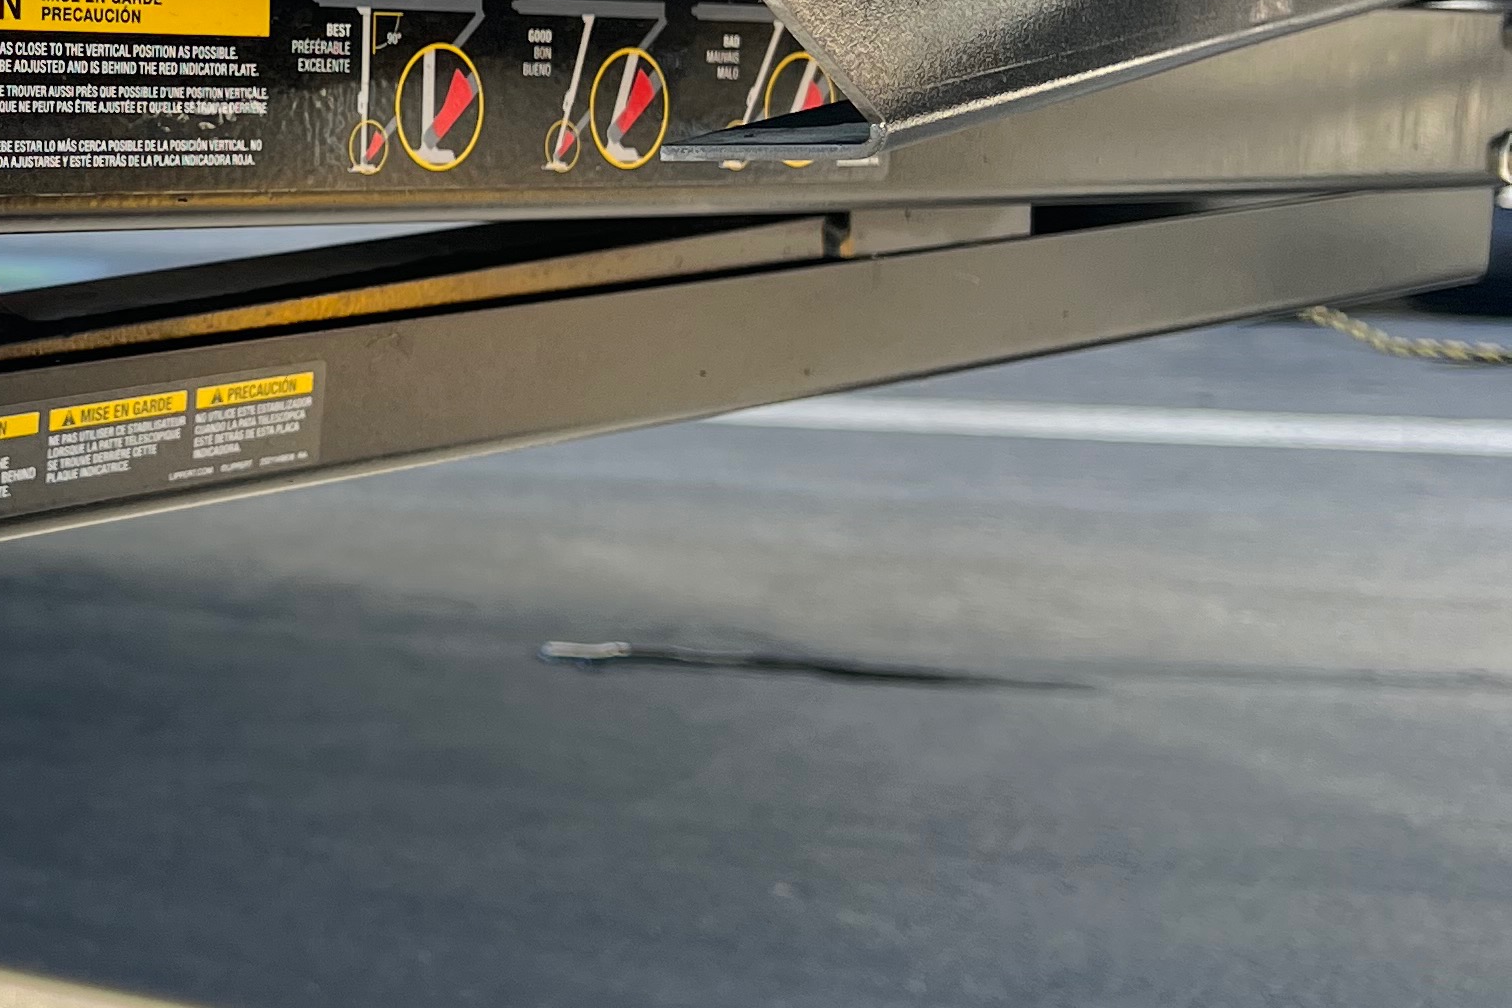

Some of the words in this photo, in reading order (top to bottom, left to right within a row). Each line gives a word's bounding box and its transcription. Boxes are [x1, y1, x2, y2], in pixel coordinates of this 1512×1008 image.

[41, 4, 143, 24] PRECAUCIÓN
[326, 22, 352, 38] BEST
[527, 28, 553, 44] GOOD
[15, 41, 48, 56] CLOSE
[49, 42, 63, 56] TO
[64, 42, 84, 57] THE
[85, 43, 131, 58] VERTICAL
[132, 44, 176, 58] POSITION
[177, 45, 191, 59] AS
[192, 45, 239, 60] POSSIBLE.
[291, 37, 351, 56] PRÉFÉRABLE
[13, 59, 66, 74] ADJUSTED
[67, 60, 88, 74] AND
[90, 61, 100, 74] IS
[101, 61, 138, 75] BEHIND
[138, 61, 158, 76] THE
[159, 61, 178, 76] RED
[179, 62, 227, 76] INDICATOR
[228, 63, 260, 77] PLATE.
[297, 57, 351, 73] EXCELENTE
[522, 62, 552, 77] BUENO
[6, 84, 47, 98] TROUVER
[48, 85, 75, 98] AUSSI
[75, 83, 99, 98] PRÈS
[99, 86, 117, 98] QUE
[119, 86, 159, 99] POSSIBLE
[160, 86, 185, 99] D'UNE
[18, 100, 31, 113] NE
[32, 100, 56, 113] PEUT
[56, 100, 73, 113] PAS
[74, 99, 97, 113] ÊTRE
[98, 99, 136, 114] AJUSTÉE
[136, 101, 148, 113] ET
[184, 101, 195, 114] SE
[14, 139, 43, 152] ESTAR
[44, 139, 56, 152] LO
[57, 137, 78, 152] MÁS
[78, 139, 107, 152] CERCA
[108, 139, 144, 152] POSIBLE
[144, 139, 156, 152] DE
[157, 139, 169, 152] LA
[169, 137, 207, 152] POSICIÓN
[208, 139, 249, 152] VERTICAL.
[250, 139, 263, 152] NO
[10, 155, 61, 168] AJUSTARSE
[62, 155, 69, 168] Y
[69, 154, 92, 168] ESTÉ
[93, 154, 127, 168] DETRÁS
[128, 155, 140, 167] DE
[140, 155, 153, 167] LA
[153, 155, 181, 167] PLACA
[182, 154, 231, 166] INDICADORA
[232, 154, 255, 166] ROJA.
[228, 376, 297, 401] PRECAUCIÓN
[80, 406, 110, 423] MISE
[114, 403, 130, 419] EN
[132, 396, 173, 416] GARDE
[0, 466, 37, 484] BEHIND
